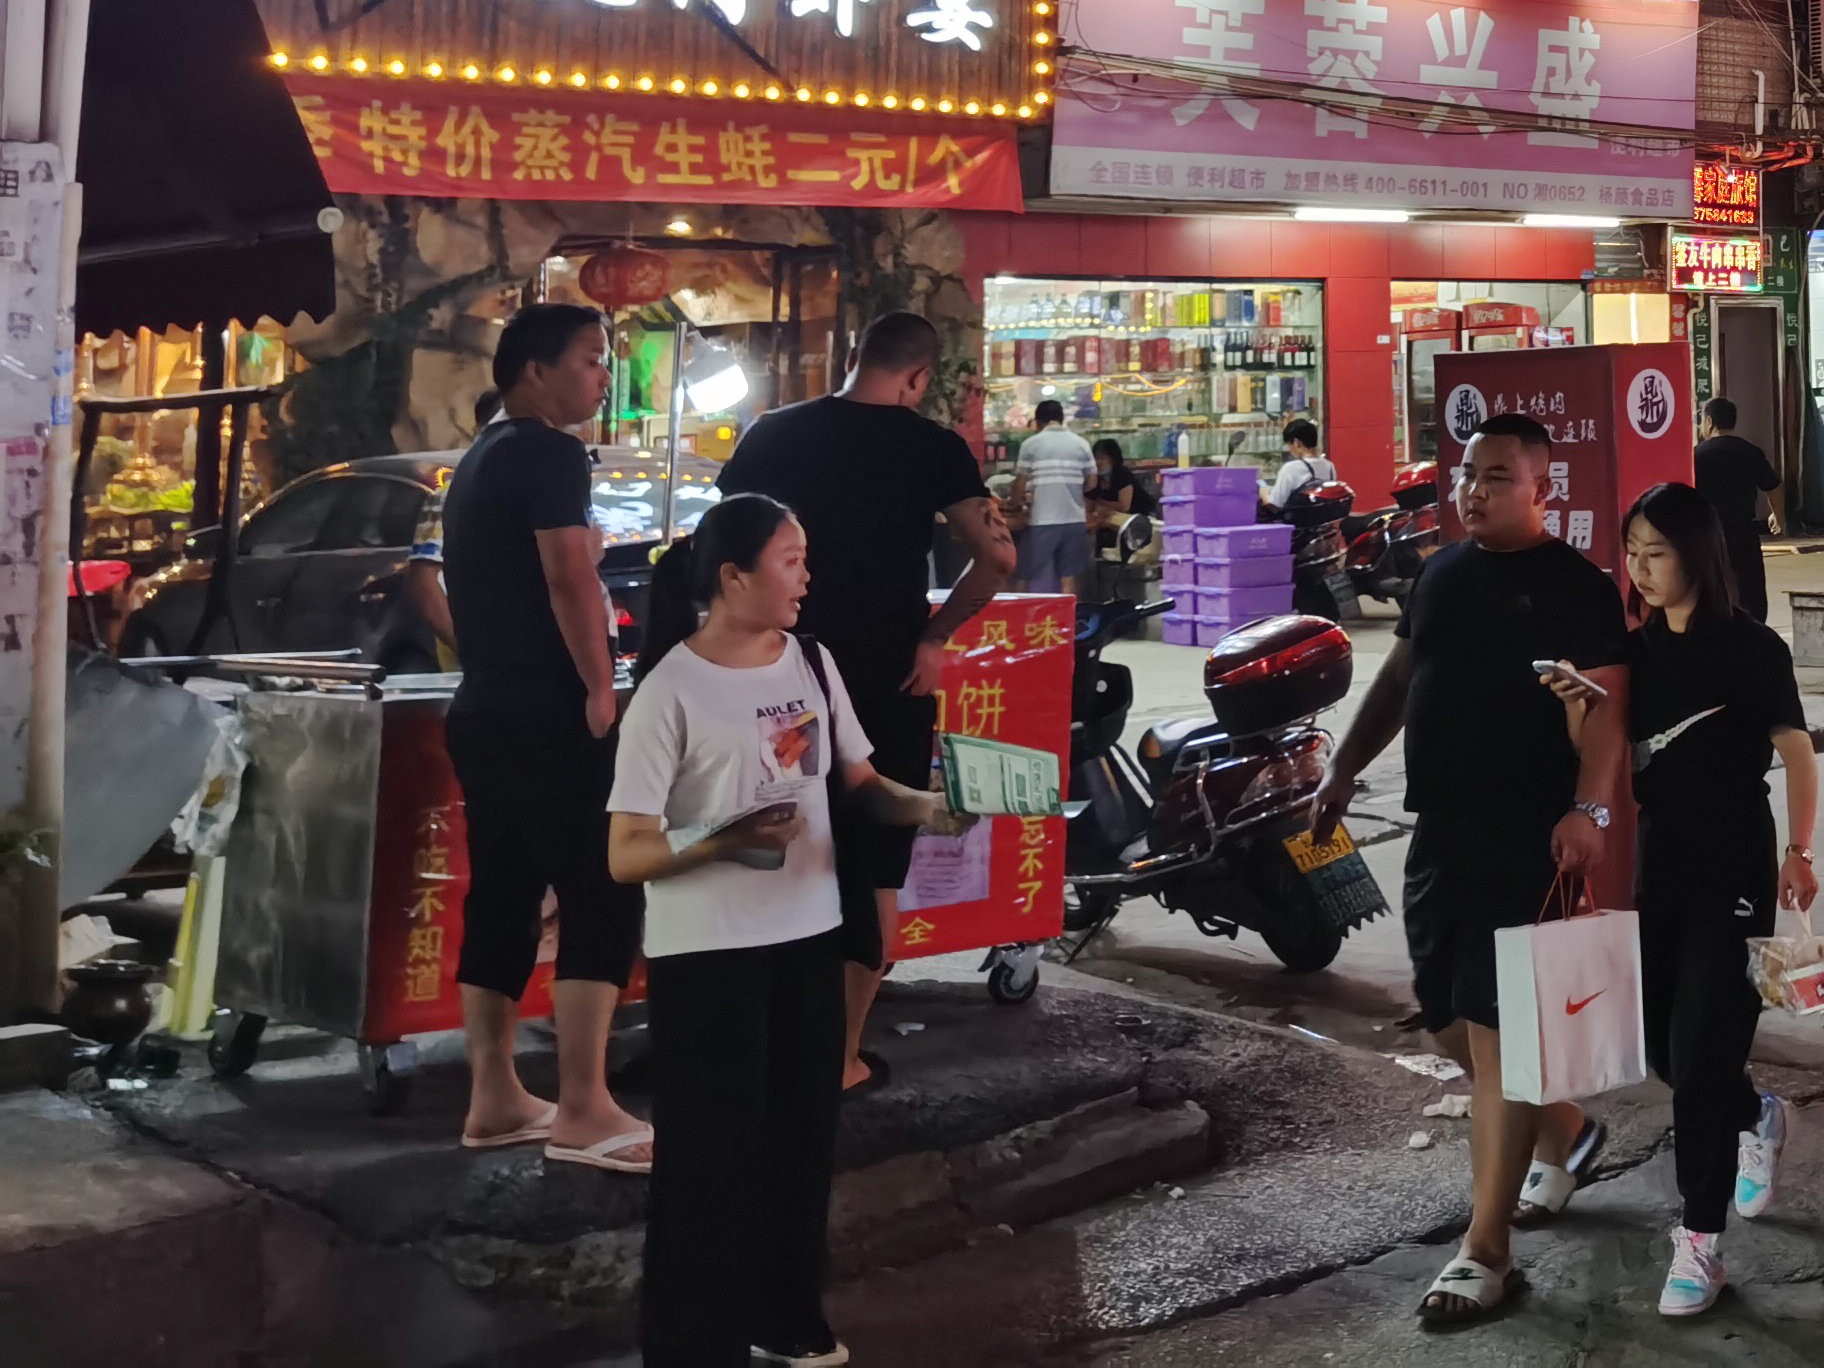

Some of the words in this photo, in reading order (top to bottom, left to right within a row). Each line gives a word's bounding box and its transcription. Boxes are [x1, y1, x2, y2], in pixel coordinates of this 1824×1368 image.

[1186, 166, 1267, 190] 便利超市
[1364, 175, 1489, 199] 400-6611-001
